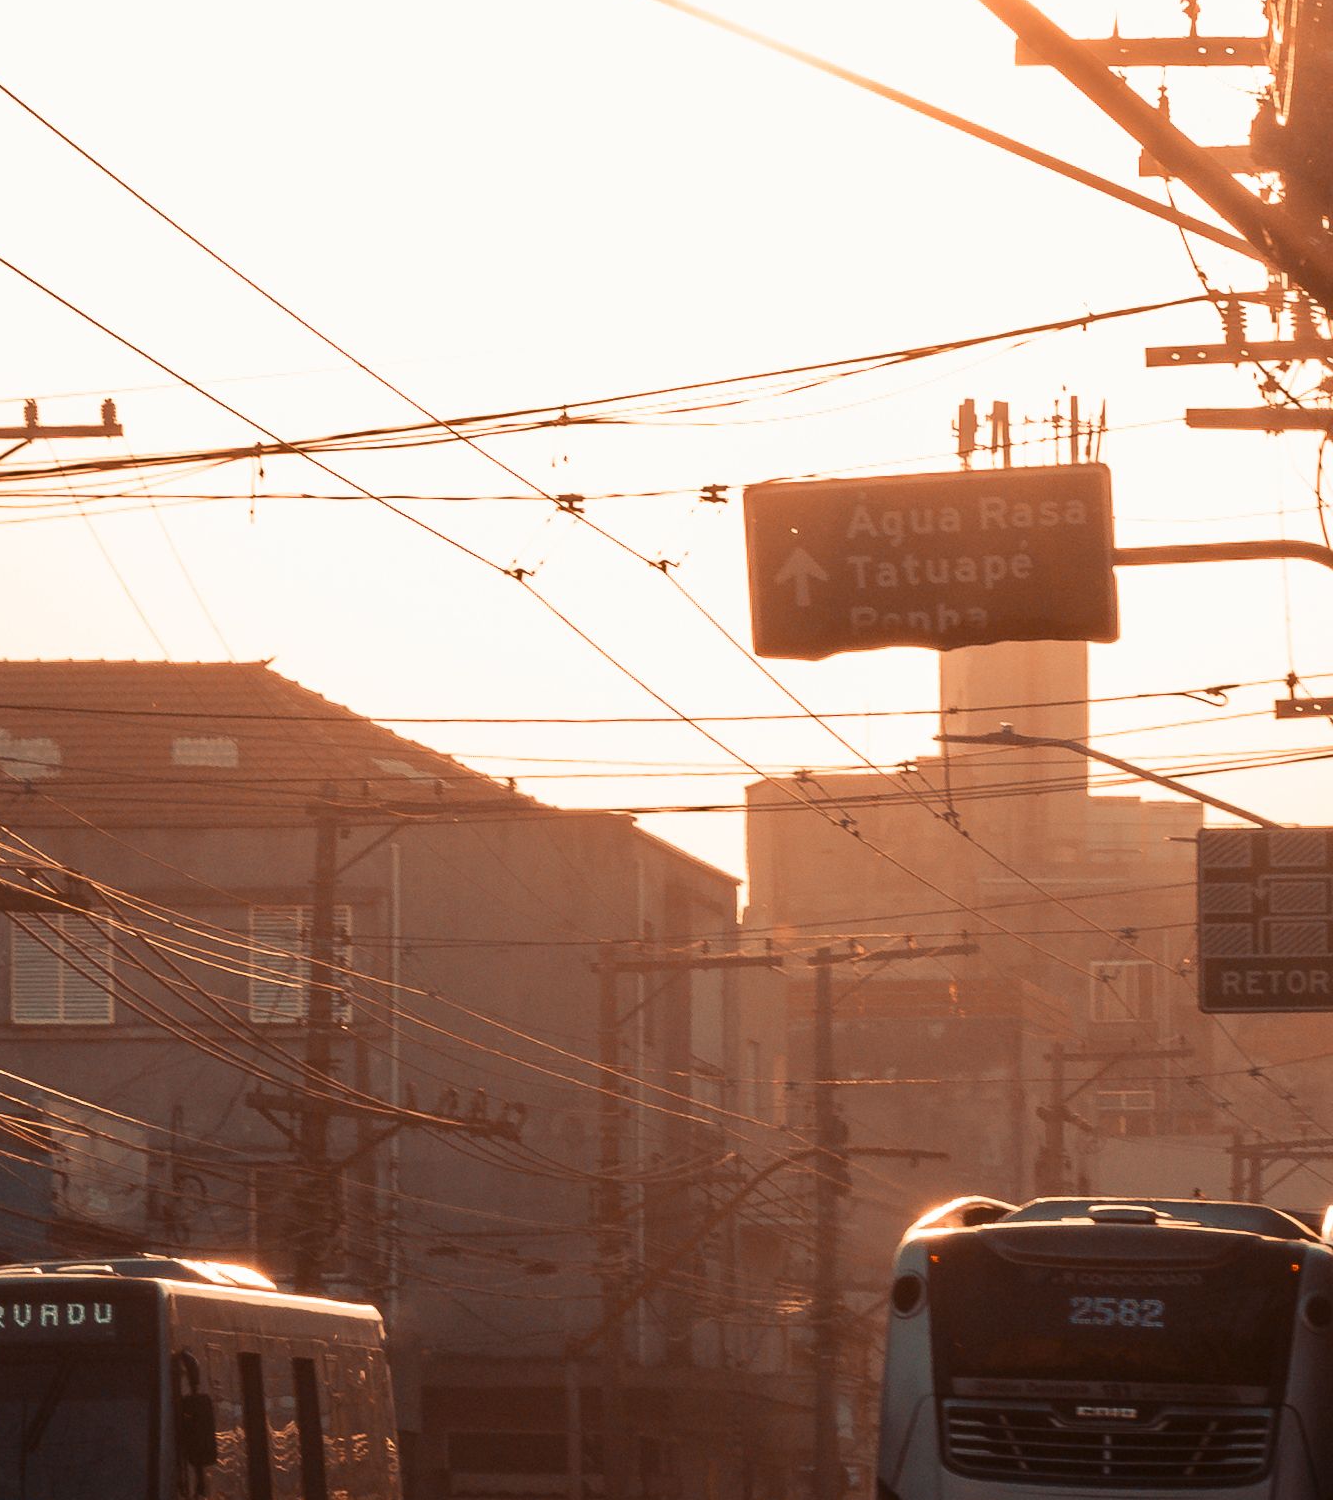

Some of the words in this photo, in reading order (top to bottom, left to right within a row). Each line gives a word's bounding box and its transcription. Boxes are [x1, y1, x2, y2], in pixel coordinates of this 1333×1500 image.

[846, 492, 961, 547] Água
[978, 496, 1087, 531] Rasa
[846, 540, 1033, 591] Tatuapé
[1068, 1296, 1165, 1328] 2582
